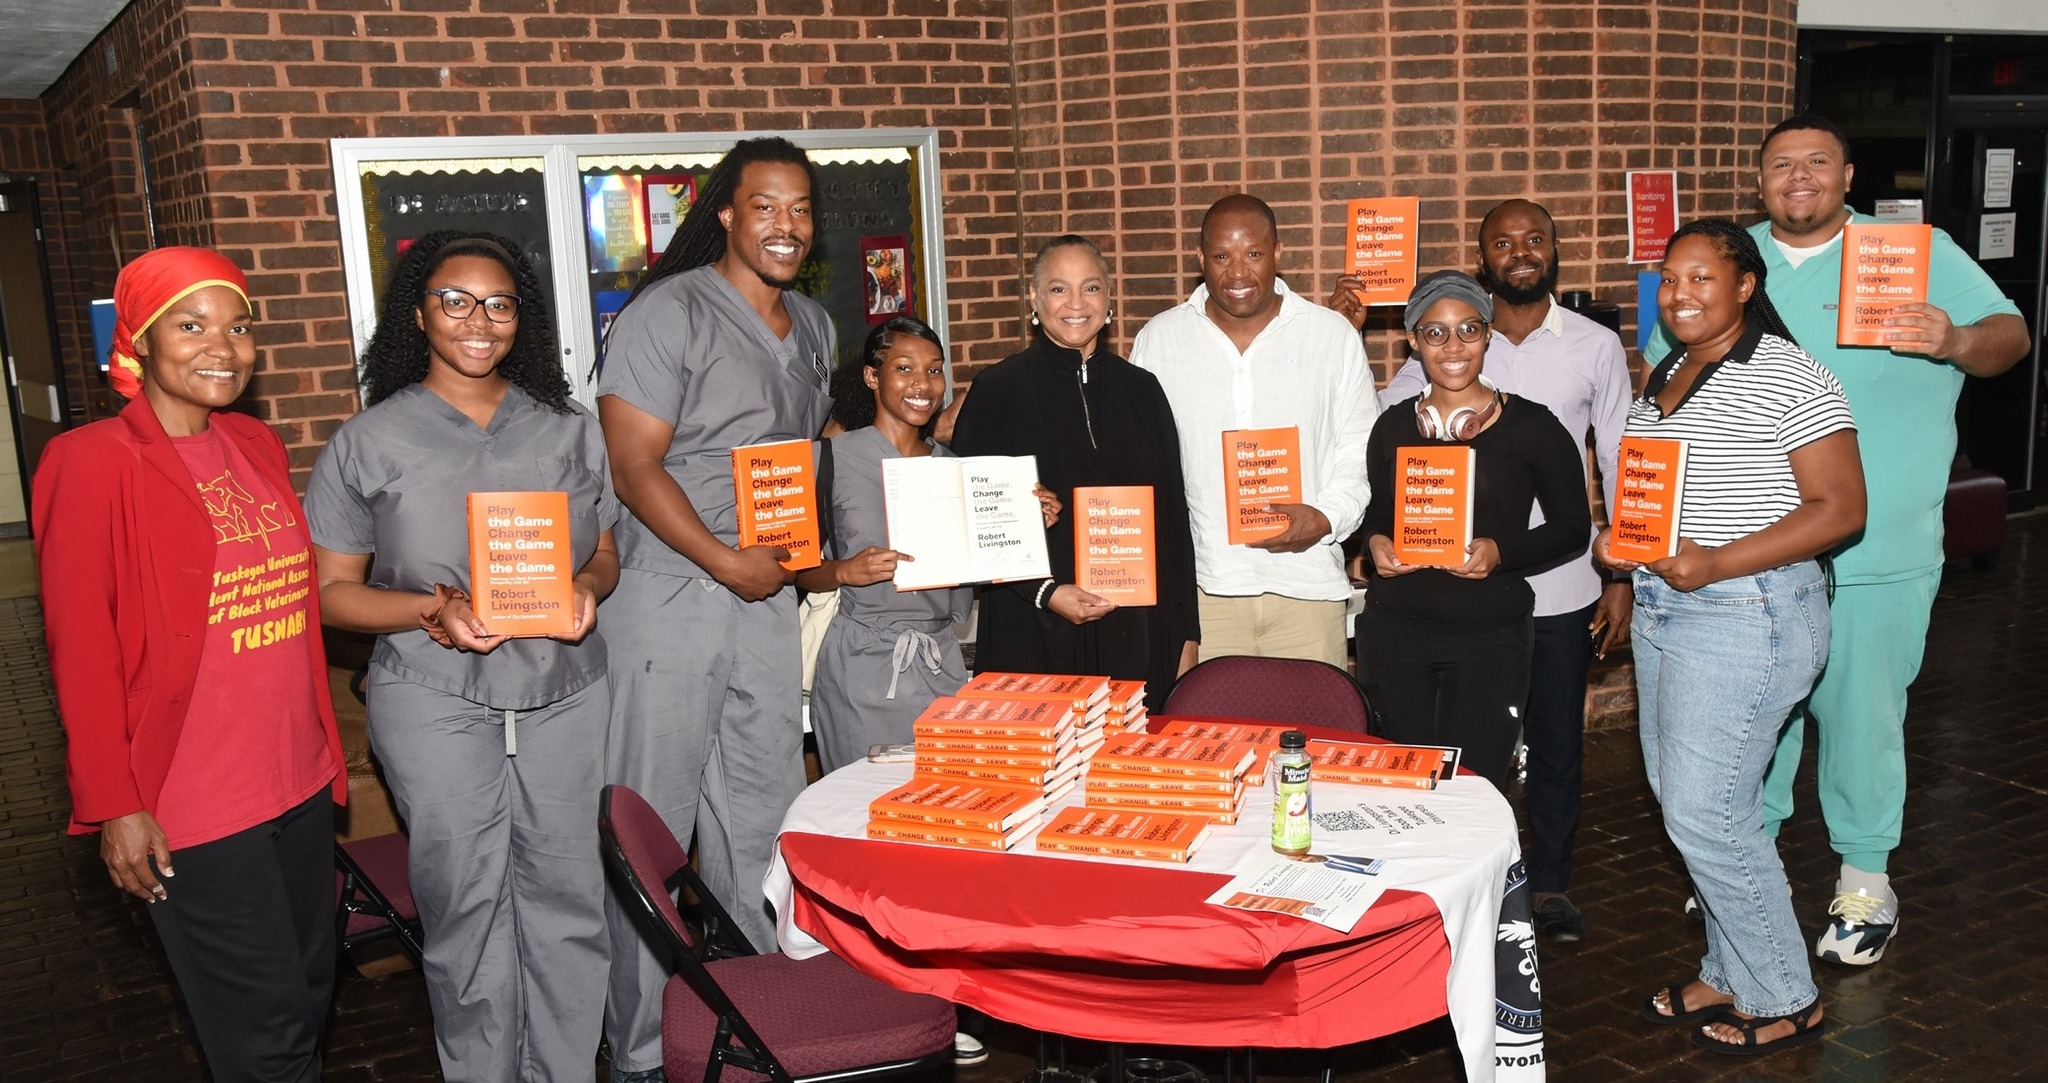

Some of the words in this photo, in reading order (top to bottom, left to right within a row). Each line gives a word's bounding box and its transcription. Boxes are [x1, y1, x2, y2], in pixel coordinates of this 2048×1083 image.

[1636, 192, 1666, 202] Sanitizing
[1357, 209, 1377, 217] Play
[1636, 205, 1657, 213] Keeps
[1357, 217, 1374, 225] the
[1375, 216, 1404, 224] Game
[1637, 216, 1654, 225] Every
[1357, 225, 1394, 234] Change
[1637, 227, 1654, 235] Germ
[1356, 234, 1373, 242] the
[1375, 233, 1403, 241] Game
[1638, 238, 1668, 246] Eliminated
[1861, 236, 1884, 245] Play
[1356, 242, 1384, 250] Leave
[1859, 245, 1879, 254] the
[1881, 245, 1916, 255] Game
[1355, 251, 1373, 259] the
[1374, 250, 1403, 258] Game
[1859, 255, 1903, 266] Change
[1356, 270, 1388, 278] Robert
[1857, 264, 1878, 274] the
[1880, 264, 1915, 274] Game
[1363, 277, 1404, 287] vingston
[1857, 275, 1890, 283] Leave
[1856, 284, 1876, 293] the
[1879, 284, 1914, 294] Game
[1856, 307, 1894, 316] Robert
[1237, 442, 1258, 450] Play
[1237, 451, 1255, 459] the
[1257, 449, 1287, 458] Game
[1627, 449, 1645, 460] Play
[751, 459, 773, 468] Play
[1238, 459, 1277, 469] Change
[1407, 457, 1427, 467] Play
[1626, 459, 1640, 468] the
[1641, 460, 1666, 471] Game
[751, 470, 770, 479] the
[772, 466, 803, 476] Game
[1238, 469, 1256, 478] the
[1258, 467, 1288, 476] Game
[1406, 467, 1424, 476] the
[1425, 466, 1455, 476] Game
[1625, 469, 1657, 480] Change
[752, 477, 792, 488] Change
[971, 476, 989, 484] Play
[1239, 478, 1268, 487] Leave
[1406, 476, 1445, 486] Change
[1624, 479, 1638, 489] the
[1639, 480, 1664, 491] Game
[753, 489, 772, 500] the
[774, 486, 804, 497] Game
[973, 489, 1004, 499] Change
[1239, 487, 1257, 496] the
[1259, 485, 1289, 494] Game
[1405, 486, 1423, 495] the
[1424, 485, 1455, 495] Game
[1623, 488, 1646, 499] Leave
[754, 500, 783, 510] Leave
[1089, 499, 1110, 508] Play
[1405, 496, 1434, 504] Leave
[1622, 498, 1636, 508] the
[1637, 499, 1662, 511] Game
[488, 506, 515, 517] Play
[755, 511, 773, 520] the
[775, 507, 806, 518] Game
[975, 505, 999, 513] Leave
[1088, 508, 1107, 516] the
[1109, 507, 1141, 516] Game
[1240, 507, 1263, 517] Rob
[1404, 505, 1422, 514] the
[1423, 505, 1454, 514] Game
[488, 517, 511, 527] the
[514, 516, 553, 527] Game
[1089, 517, 1130, 527] Change
[1620, 520, 1647, 531] Robert
[489, 529, 540, 539] Change
[1088, 527, 1107, 535] the
[1110, 526, 1142, 535] Game
[1404, 526, 1437, 535] Robert
[757, 532, 792, 543] Robert
[978, 533, 1006, 541] Robert
[1089, 537, 1120, 545] Leave
[1403, 536, 1455, 547] Livingston
[1618, 530, 1660, 543] Livingston
[489, 540, 512, 550] the
[515, 540, 554, 550] Game
[979, 539, 1021, 549] Livingston
[1089, 546, 1108, 555] the
[1110, 545, 1142, 554] Game
[490, 552, 528, 561] Leave
[490, 563, 513, 573] the
[516, 562, 556, 572] Game
[1090, 568, 1127, 576] Robert
[213, 565, 266, 587] Tuskegee
[243, 572, 286, 598] National
[1090, 577, 1145, 587] Livingston
[492, 590, 536, 599] Robert
[208, 608, 226, 624] of
[228, 598, 262, 620] Black
[492, 601, 560, 612] Livingston
[916, 726, 934, 734] PLAY
[985, 729, 1006, 737] LEAVE
[1122, 764, 1150, 772] CHANGE
[1285, 767, 1310, 777] Minute
[1288, 774, 1308, 782] Maid
[1322, 773, 1349, 781] CHANGE
[871, 810, 888, 818] PLAY
[898, 813, 925, 821] CHANGE
[936, 817, 956, 825] LEAVE
[1070, 845, 1099, 853] CHANGE
[1496, 1008, 1541, 1028] ETERI
